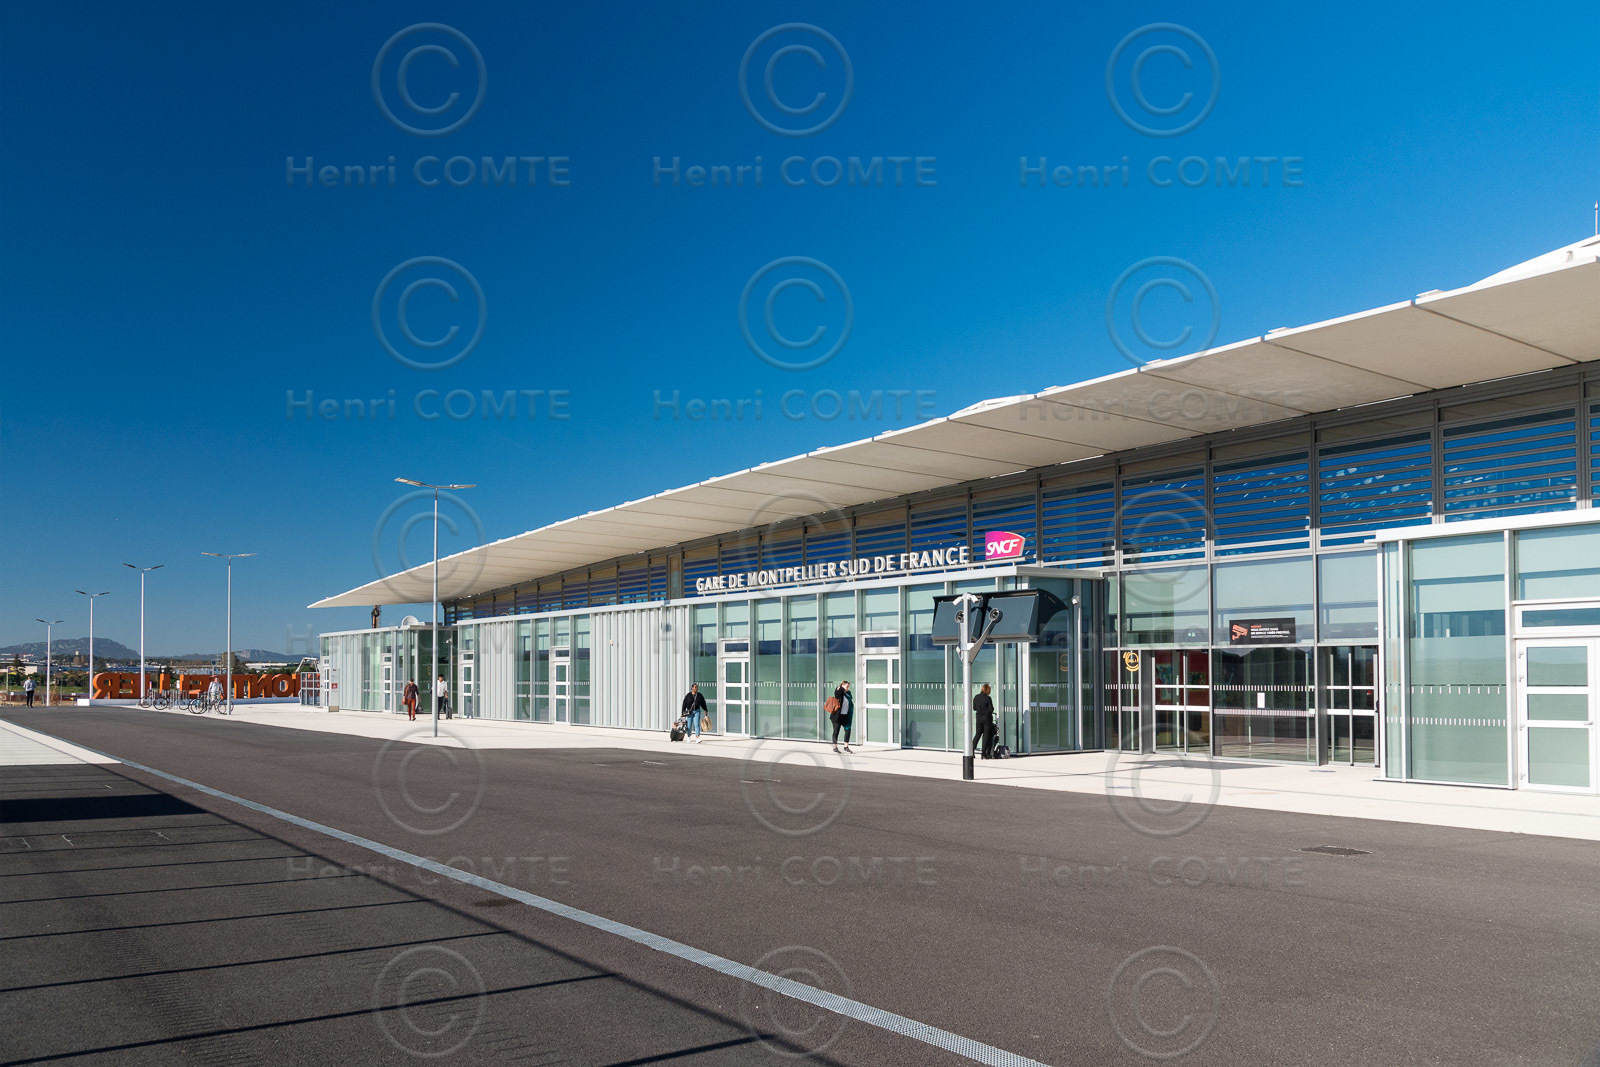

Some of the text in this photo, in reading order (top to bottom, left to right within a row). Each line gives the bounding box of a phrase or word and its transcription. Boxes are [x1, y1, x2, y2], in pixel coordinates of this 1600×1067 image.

[986, 539, 1020, 556] SNCF
[696, 546, 970, 591] GARE DE MONTPELLIER SUD DE FRANCE
